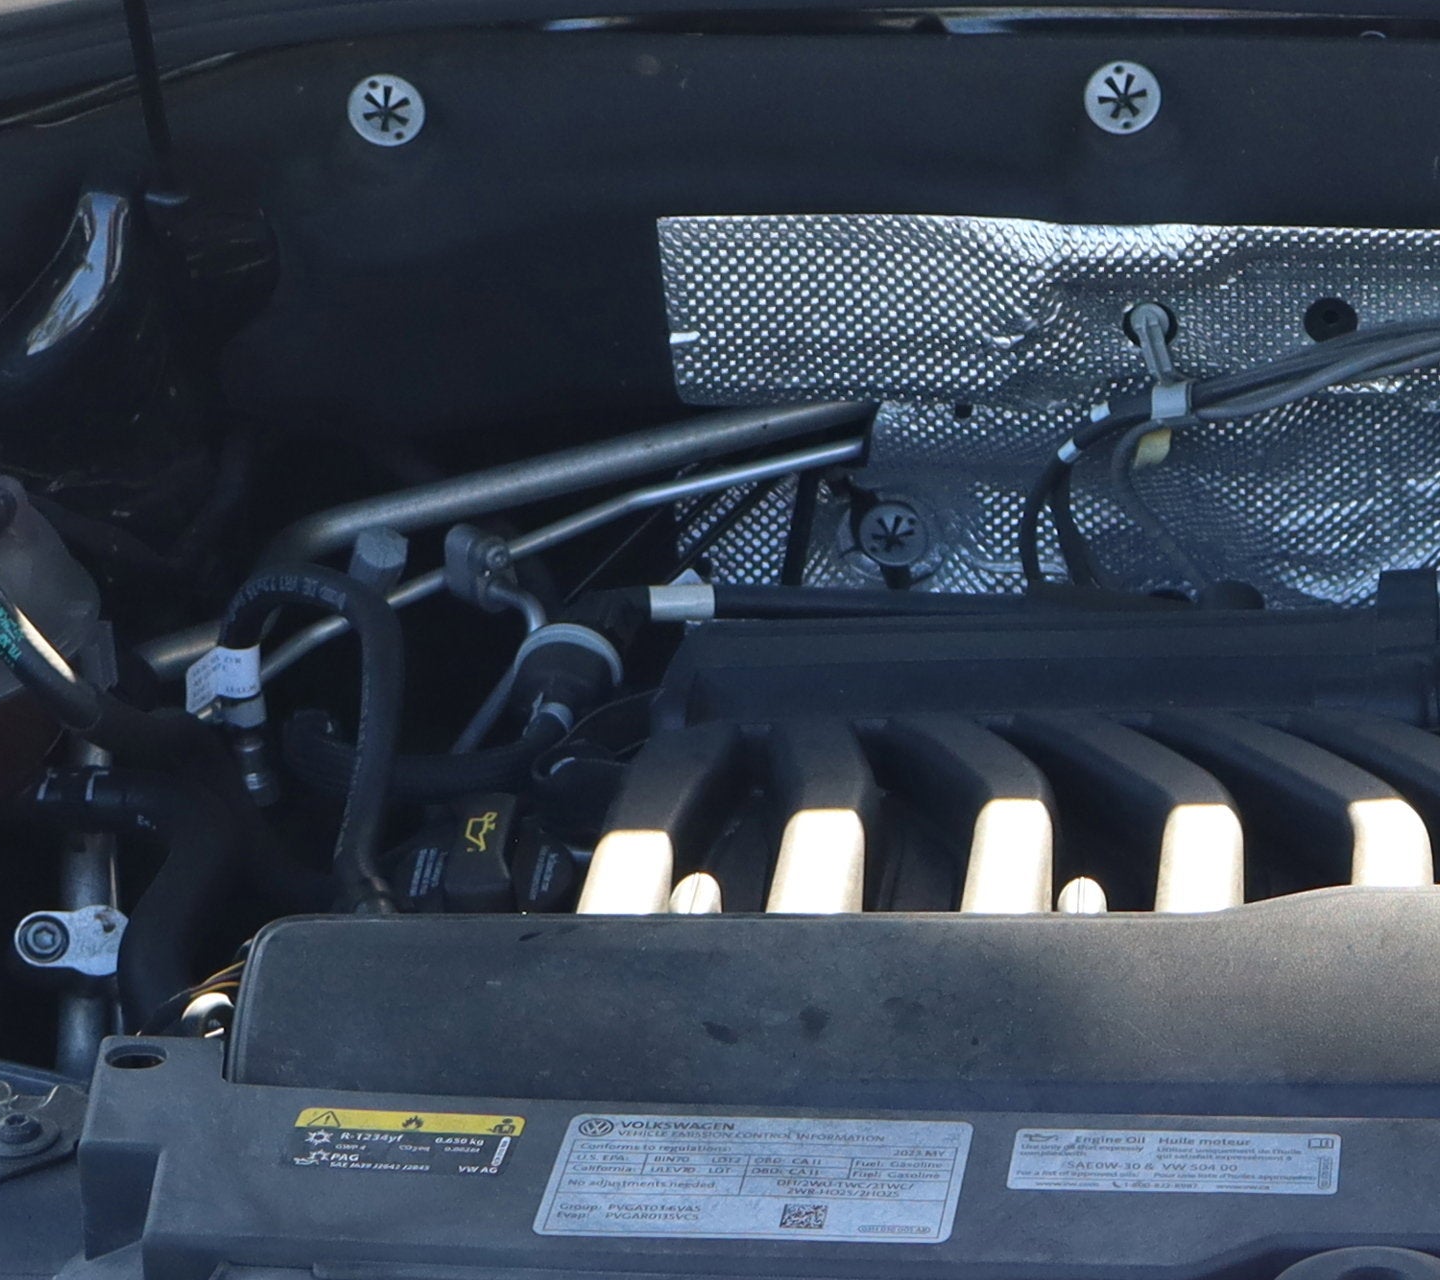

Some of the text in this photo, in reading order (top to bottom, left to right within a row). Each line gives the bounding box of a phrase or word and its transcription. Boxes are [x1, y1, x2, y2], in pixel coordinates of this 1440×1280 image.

[621, 1120, 736, 1131] VOLKSWAGEN
[340, 1132, 404, 1143] R-1234yf
[618, 1130, 886, 1142] VEHICLE EMISSION CONTROL INFORMATION
[1075, 1136, 1251, 1146] Engine Oil Huile moteur
[580, 1143, 640, 1151] Conforms
[330, 1153, 360, 1162] PAG
[458, 1165, 479, 1173] VW
[479, 1166, 498, 1174] AG
[890, 1161, 944, 1169] Gasoline
[1067, 1161, 1094, 1170] SAE
[1162, 1163, 1187, 1171] VW
[887, 1172, 941, 1180] Gasoline
[567, 1179, 585, 1187] No
[589, 1179, 667, 1189] adjustments
